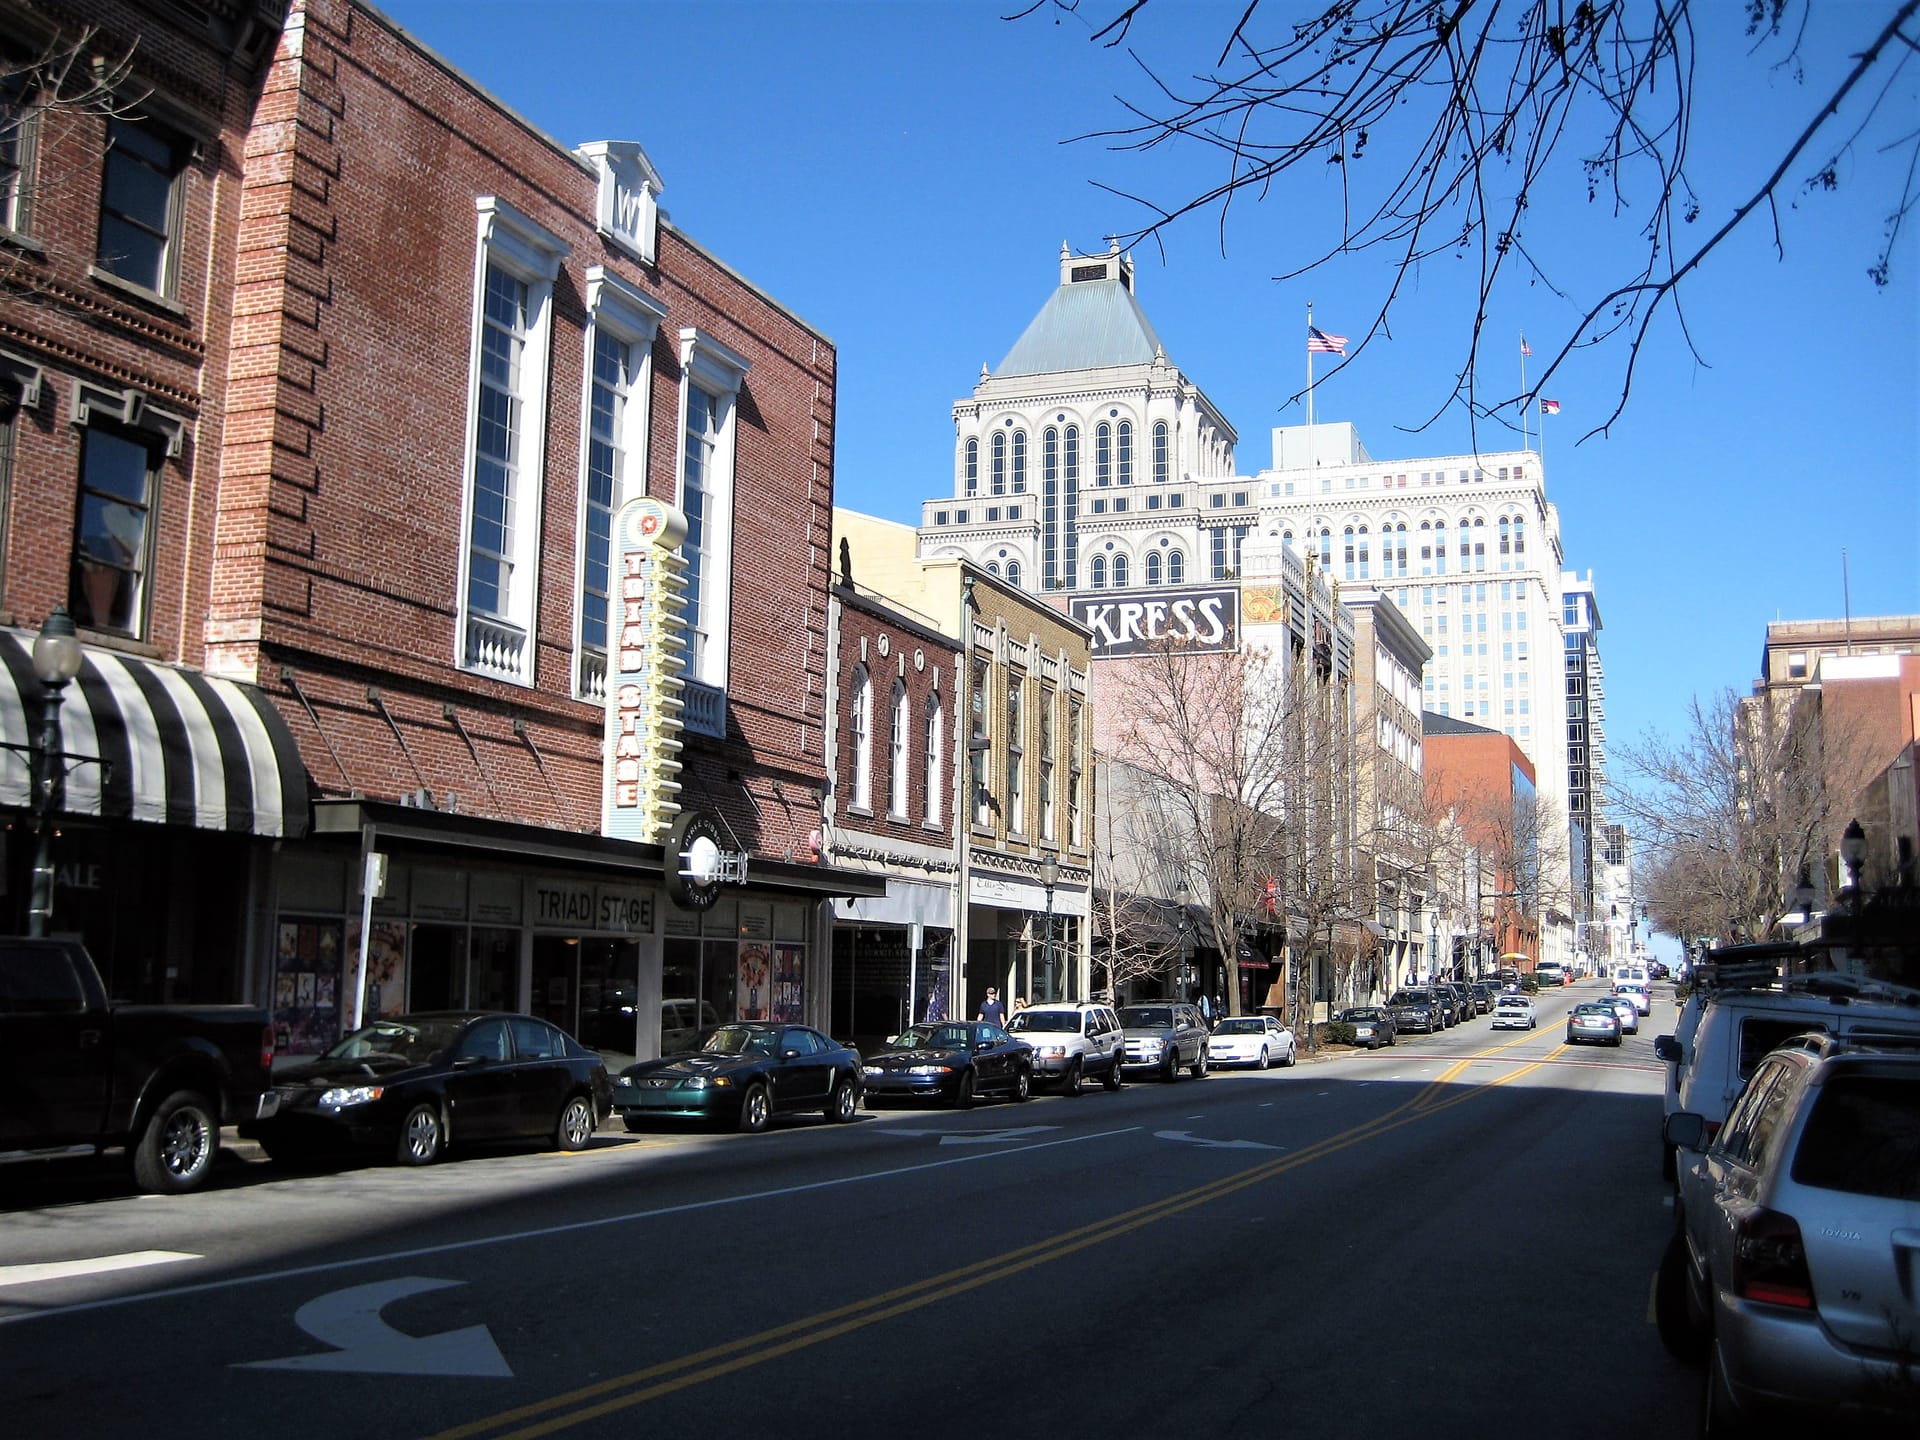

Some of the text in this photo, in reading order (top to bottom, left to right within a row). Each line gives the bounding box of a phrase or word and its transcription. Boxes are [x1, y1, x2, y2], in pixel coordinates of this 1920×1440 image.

[1085, 597, 1225, 649] KRESS
[615, 551, 646, 808] TRIAD STAGE
[55, 863, 103, 889] ALE
[537, 889, 591, 921] TRIAD
[600, 895, 650, 926] STAGE
[1821, 1227, 1863, 1241] TOYOTA
